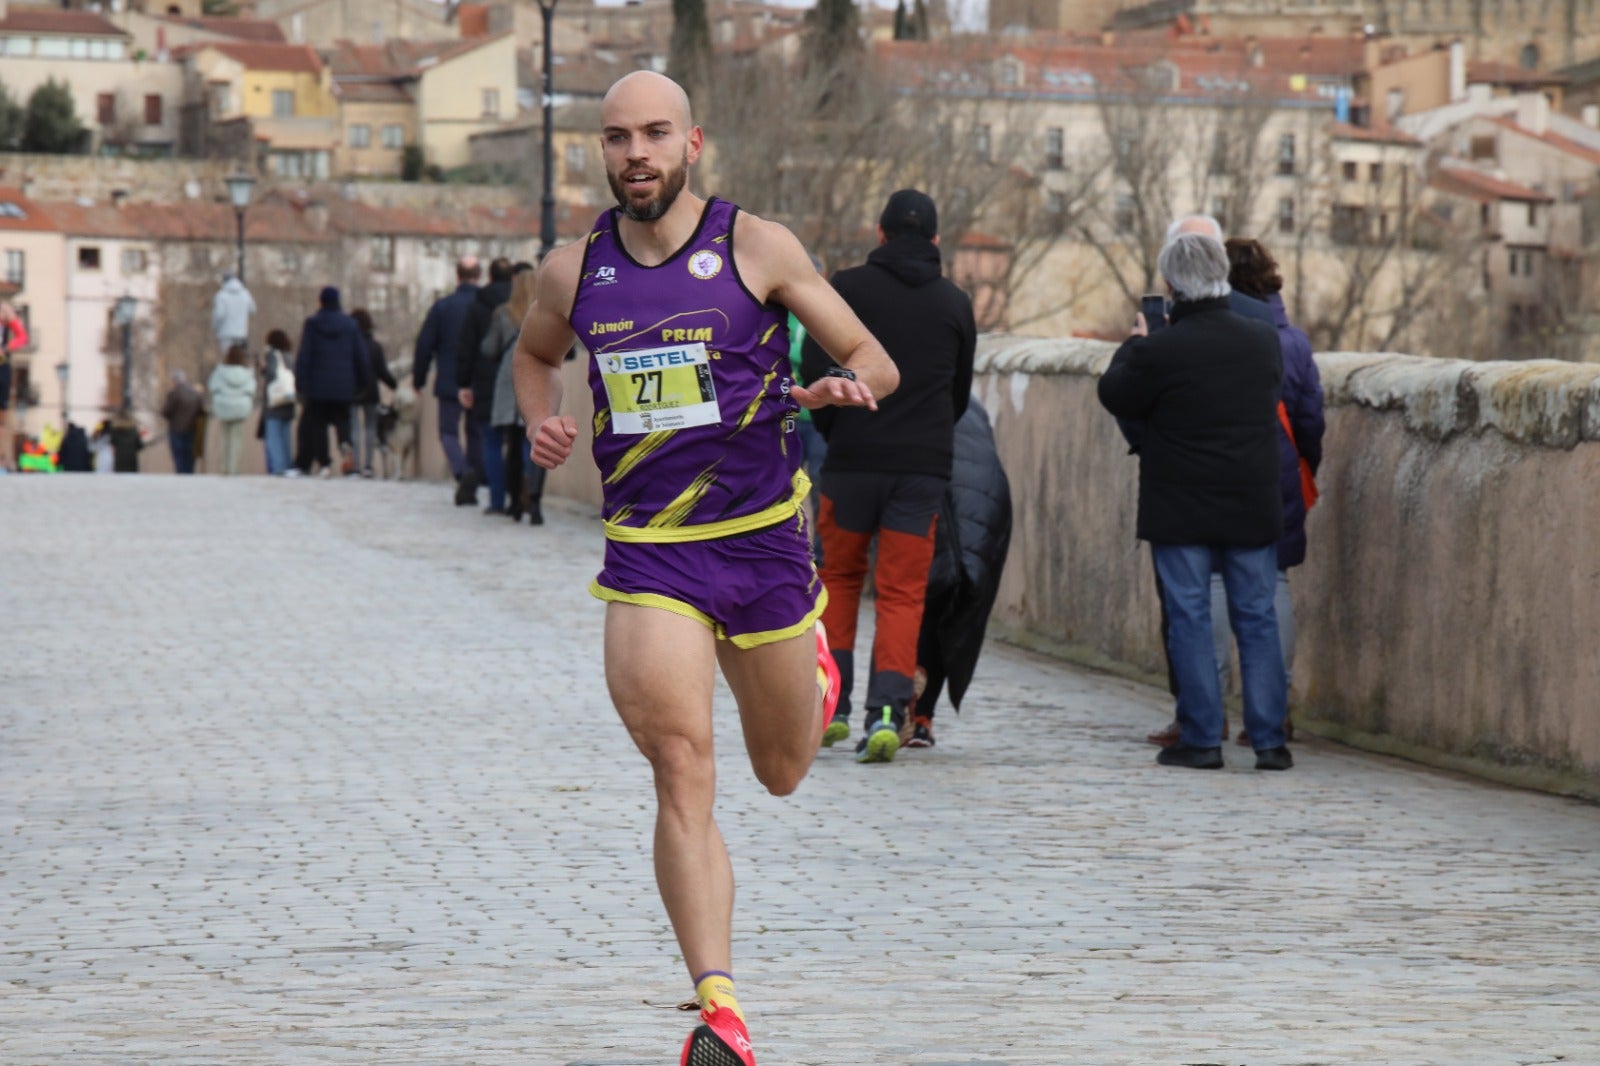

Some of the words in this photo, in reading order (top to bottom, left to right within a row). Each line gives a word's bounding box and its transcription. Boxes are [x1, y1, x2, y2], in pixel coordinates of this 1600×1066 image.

[589, 318, 634, 335] Jamón
[662, 327, 713, 342] PRIM
[624, 350, 696, 370] SETEL
[631, 371, 663, 405] 27
